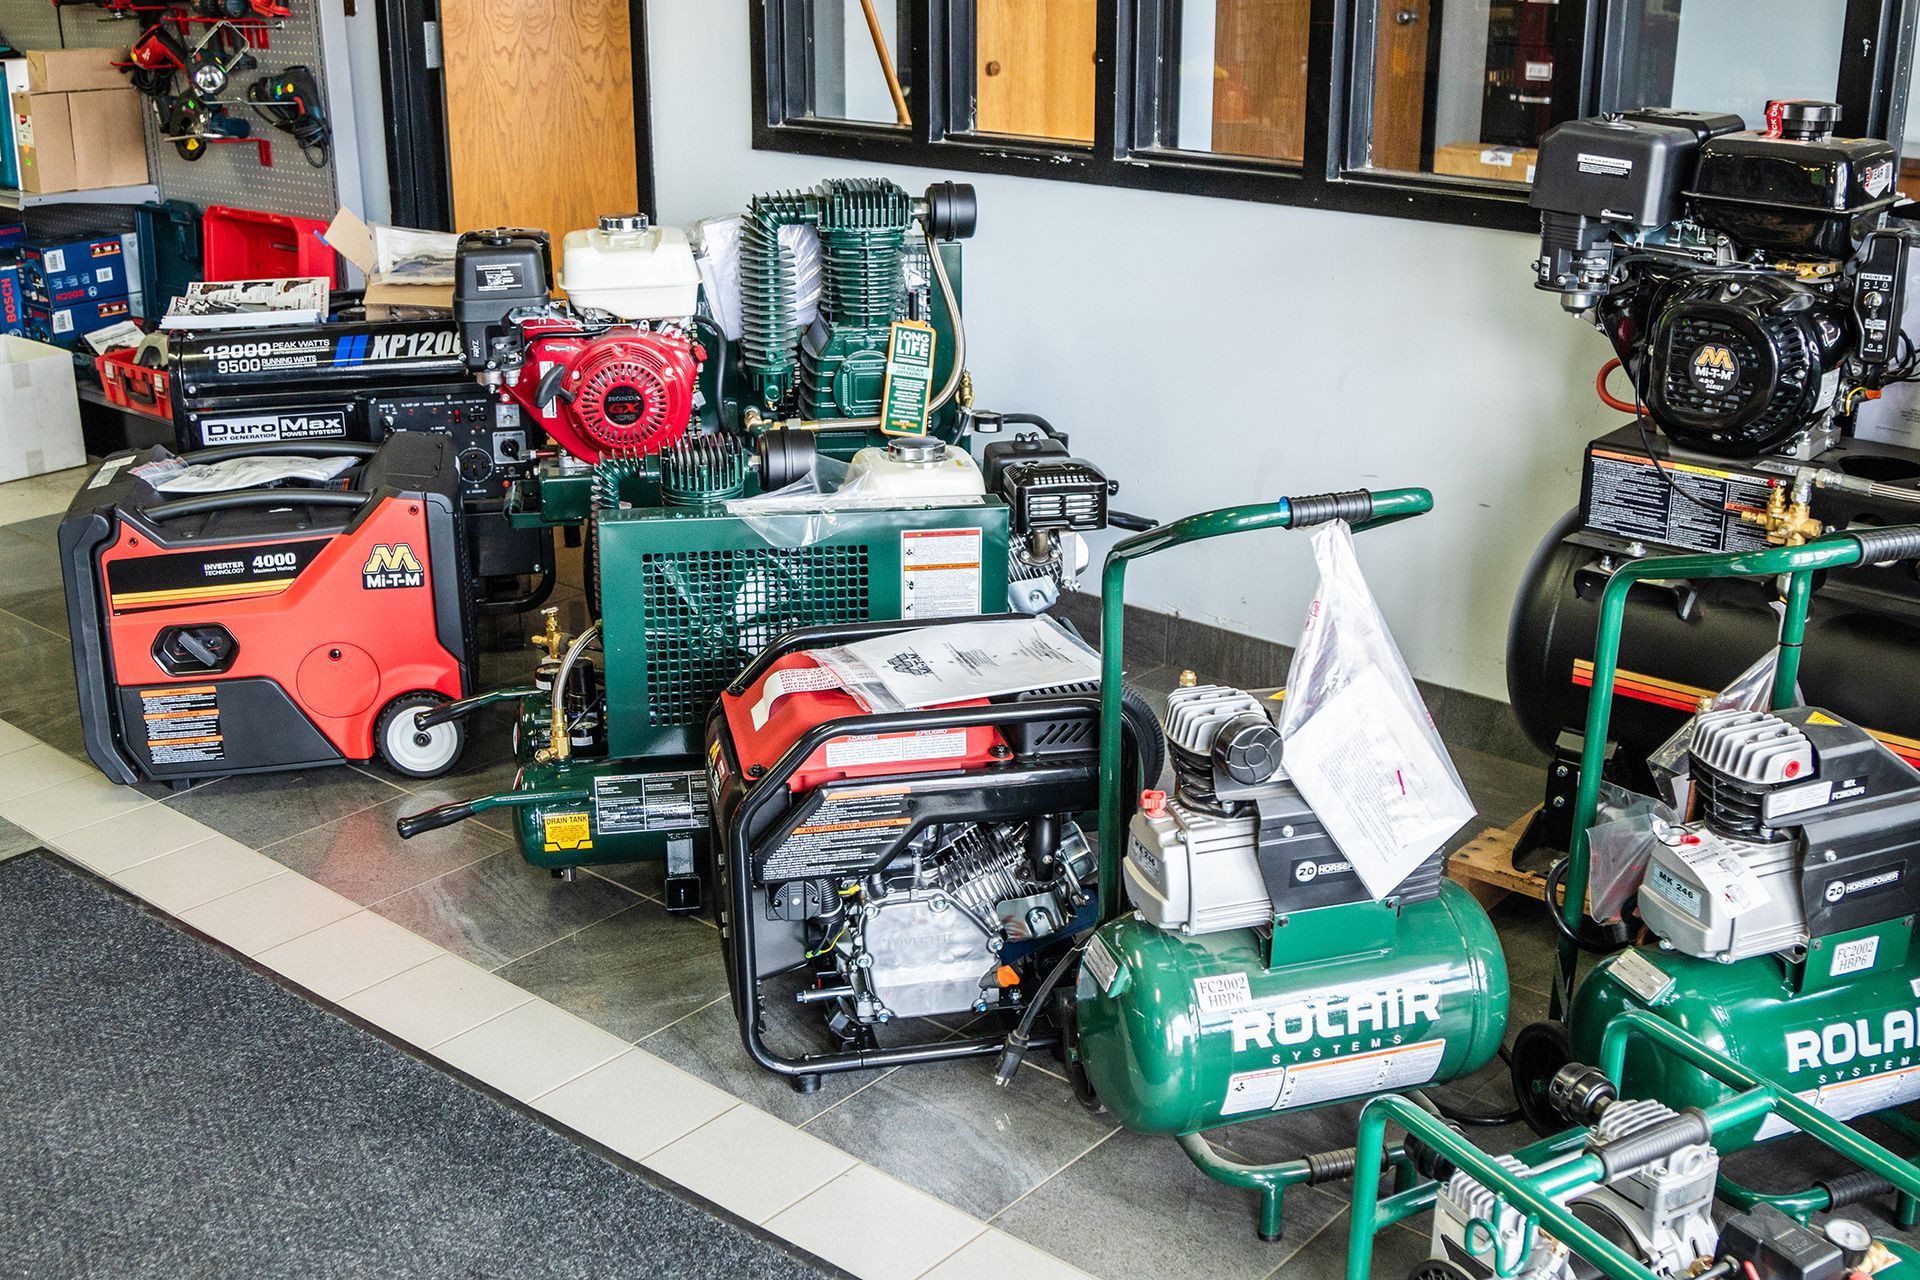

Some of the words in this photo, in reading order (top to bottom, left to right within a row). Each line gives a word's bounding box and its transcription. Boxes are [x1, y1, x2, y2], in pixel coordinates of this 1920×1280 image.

[1771, 103, 1780, 117] OIL
[2, 278, 17, 323] BOSCH
[897, 330, 930, 343] LONG
[203, 342, 271, 360] 12000
[273, 341, 296, 349] PEAK
[297, 339, 330, 348] WATTS
[896, 340, 929, 357] LIFE
[217, 358, 261, 374] 9500
[262, 356, 292, 366] RUNNING
[293, 354, 317, 363] WATTS
[1695, 366, 1732, 381] Mi-T-M
[609, 402, 639, 414] GX
[230, 433, 276, 441] GENERATION
[282, 430, 308, 438] POWER
[309, 428, 342, 436] SYSTEMS
[203, 561, 244, 571] INVERTER
[252, 552, 296, 568] 4000
[205, 567, 245, 576] TECHNOLOGY
[366, 573, 420, 588] Mi-T-M
[546, 816, 568, 825] DRAIN
[570, 815, 588, 823] TANK
[1299, 866, 1315, 877] 2.0
[1659, 871, 1673, 886] MK
[1676, 883, 1694, 899] 246
[1829, 886, 1843, 897] 2.0
[1846, 870, 1900, 894] HORSEPOWER
[1837, 941, 1875, 960] FC2002
[1839, 954, 1868, 972] HBP6
[1200, 976, 1246, 994] FC2002
[1208, 991, 1244, 1008] HBP6
[1232, 983, 1442, 1052] ROLAIR
[1272, 1035, 1402, 1064] SYSTEMS
